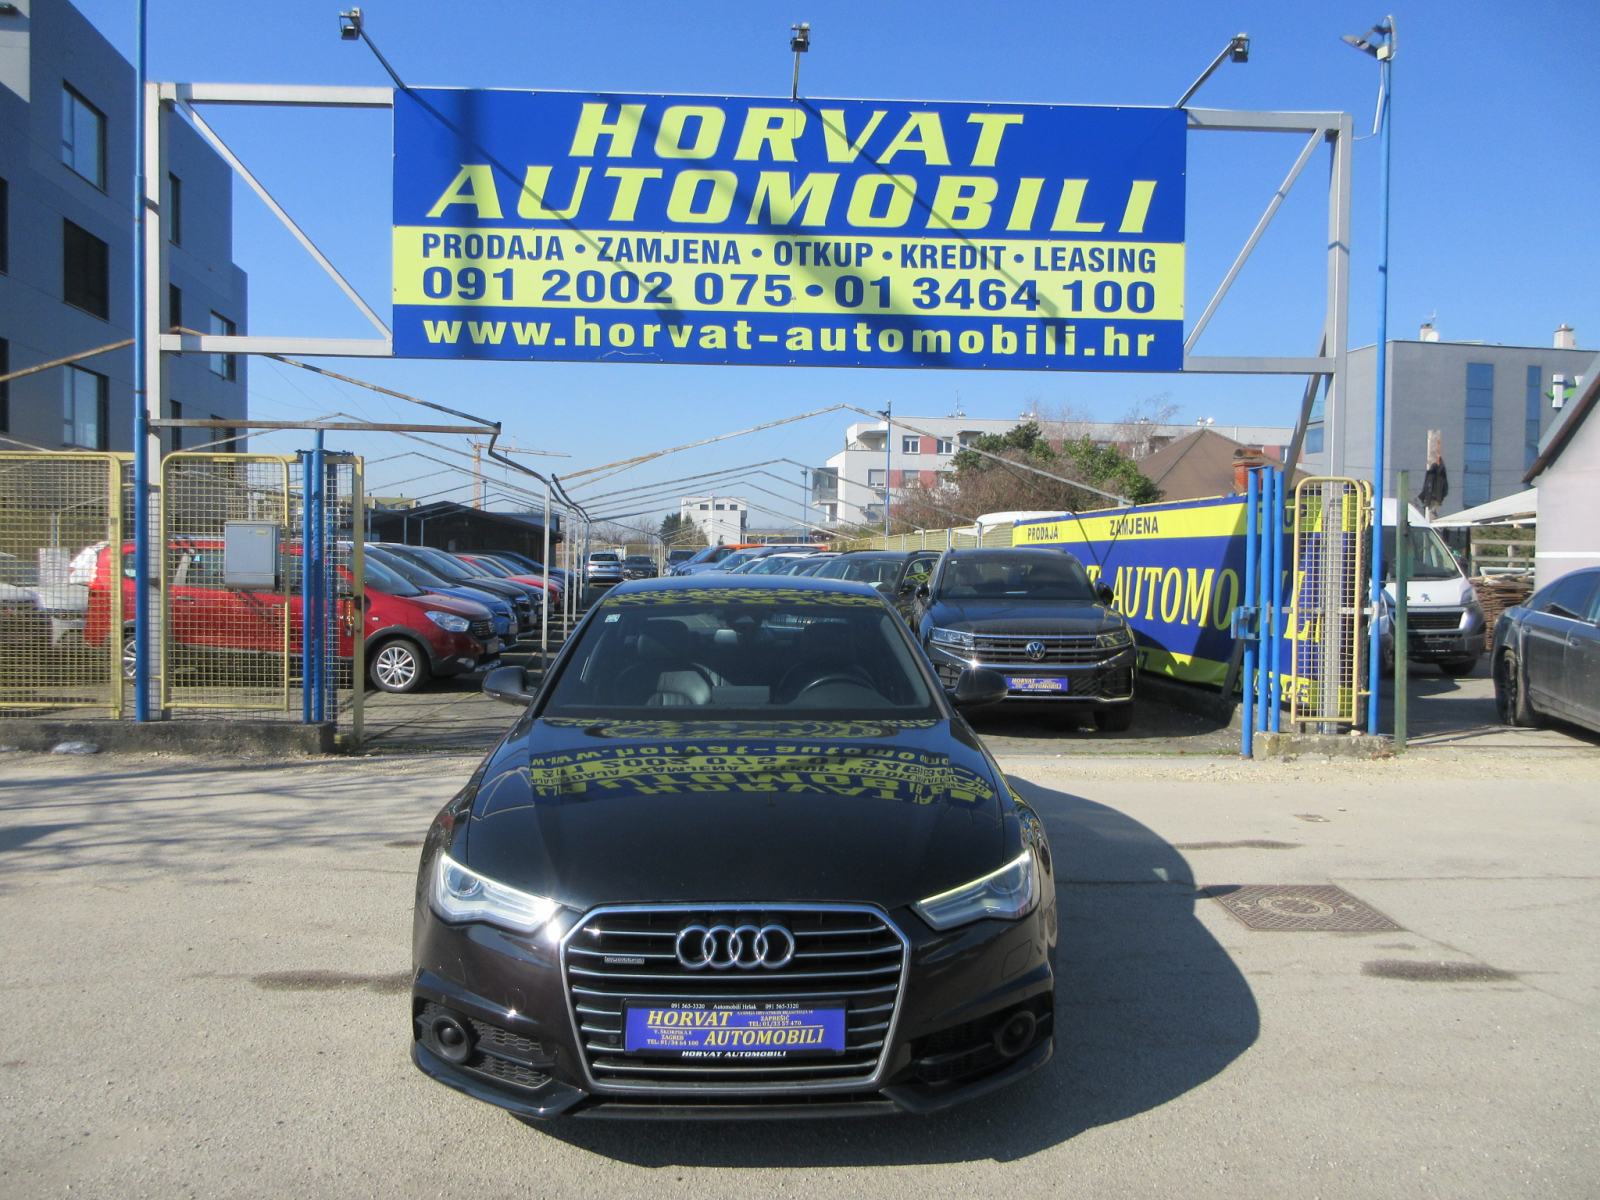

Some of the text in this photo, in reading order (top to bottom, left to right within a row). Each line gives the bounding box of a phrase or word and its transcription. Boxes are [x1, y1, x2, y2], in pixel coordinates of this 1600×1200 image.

[568, 102, 1024, 167] HORVAT
[426, 164, 1158, 233] AUTOMOBILI
[422, 233, 1156, 273] PRODAJA ZAMJENA OTKUP KREDIT LEASING
[422, 266, 1155, 314] 091 2002 075 01 3464 100
[423, 316, 1155, 357] www.horvat-automobili.hr
[1027, 516, 1159, 541] PRODAJA ZAMJENA
[647, 1010, 734, 1026] HORVAT
[704, 1028, 825, 1046] AUTOMOBILI
